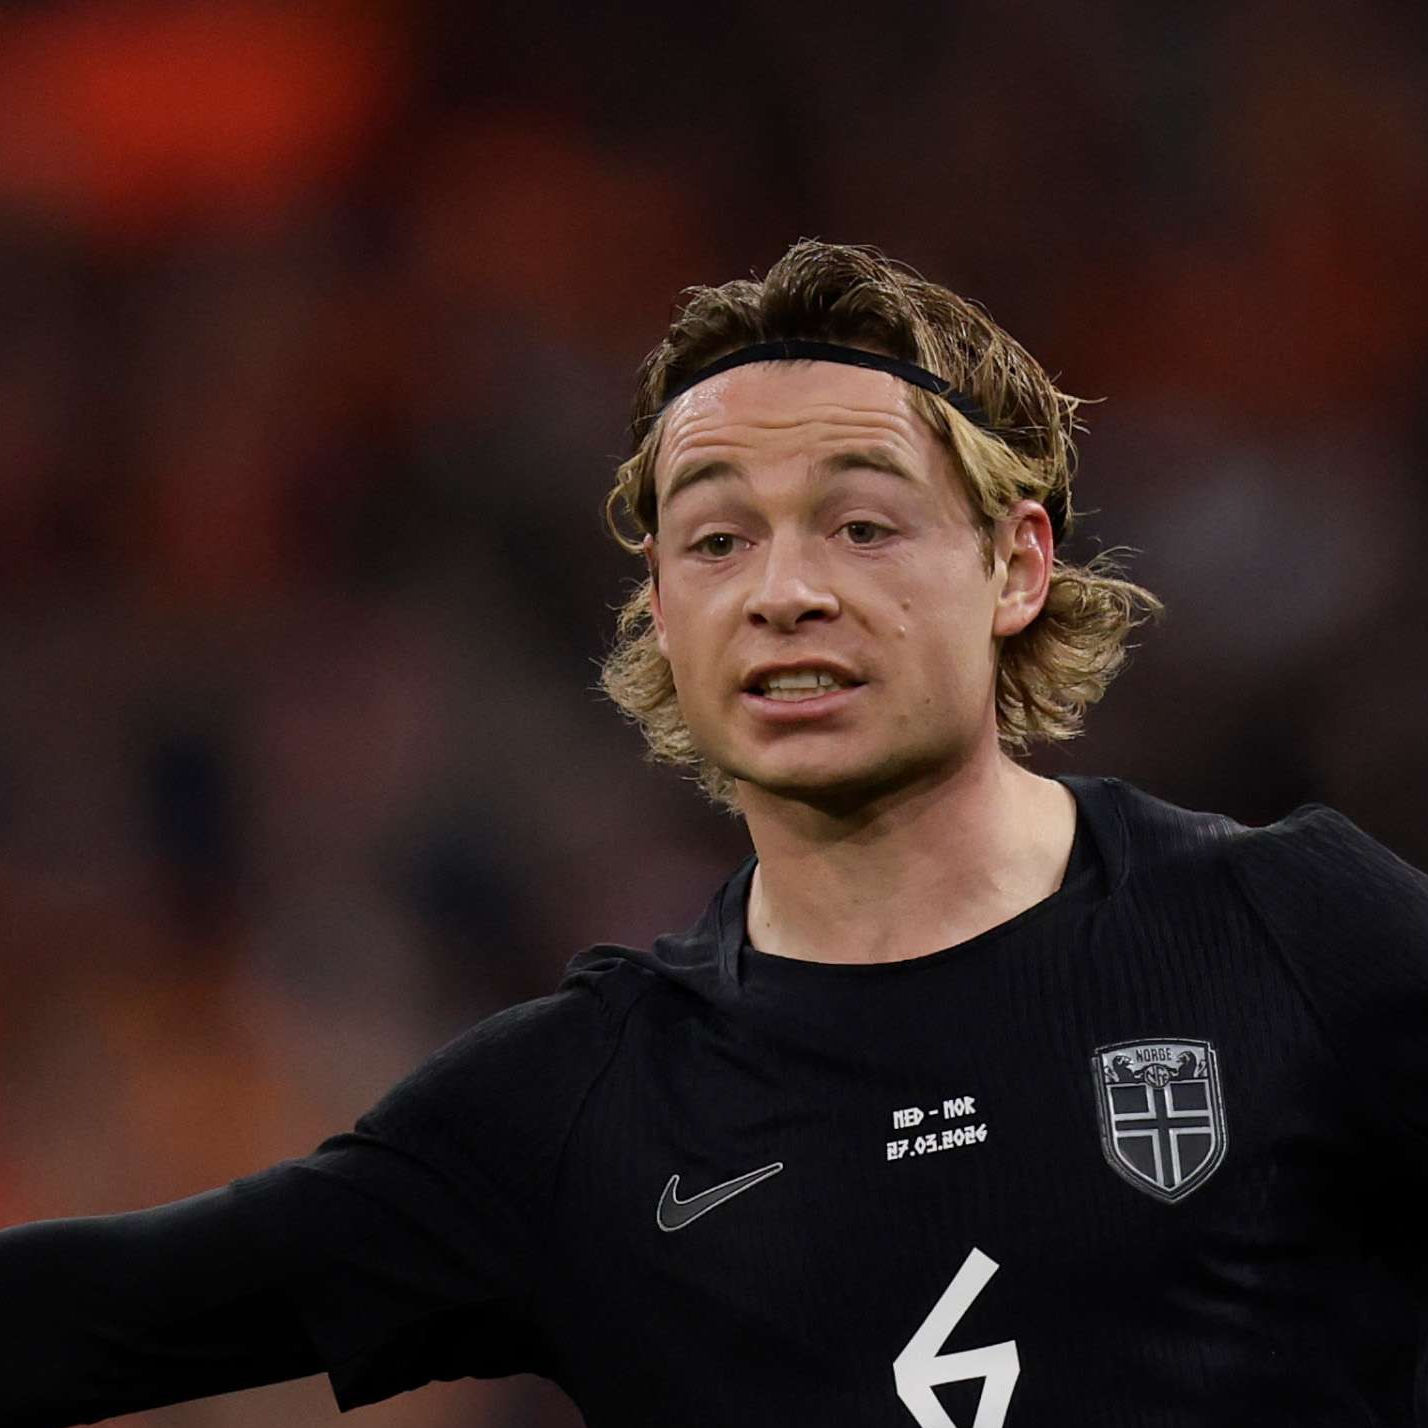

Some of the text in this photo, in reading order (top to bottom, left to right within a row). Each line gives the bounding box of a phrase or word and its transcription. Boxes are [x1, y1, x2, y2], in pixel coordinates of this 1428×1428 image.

[1136, 1047, 1172, 1063] NORGE
[893, 1107, 924, 1130] NED
[943, 1096, 976, 1120] NOR
[886, 1123, 988, 1161] 27.03.2026
